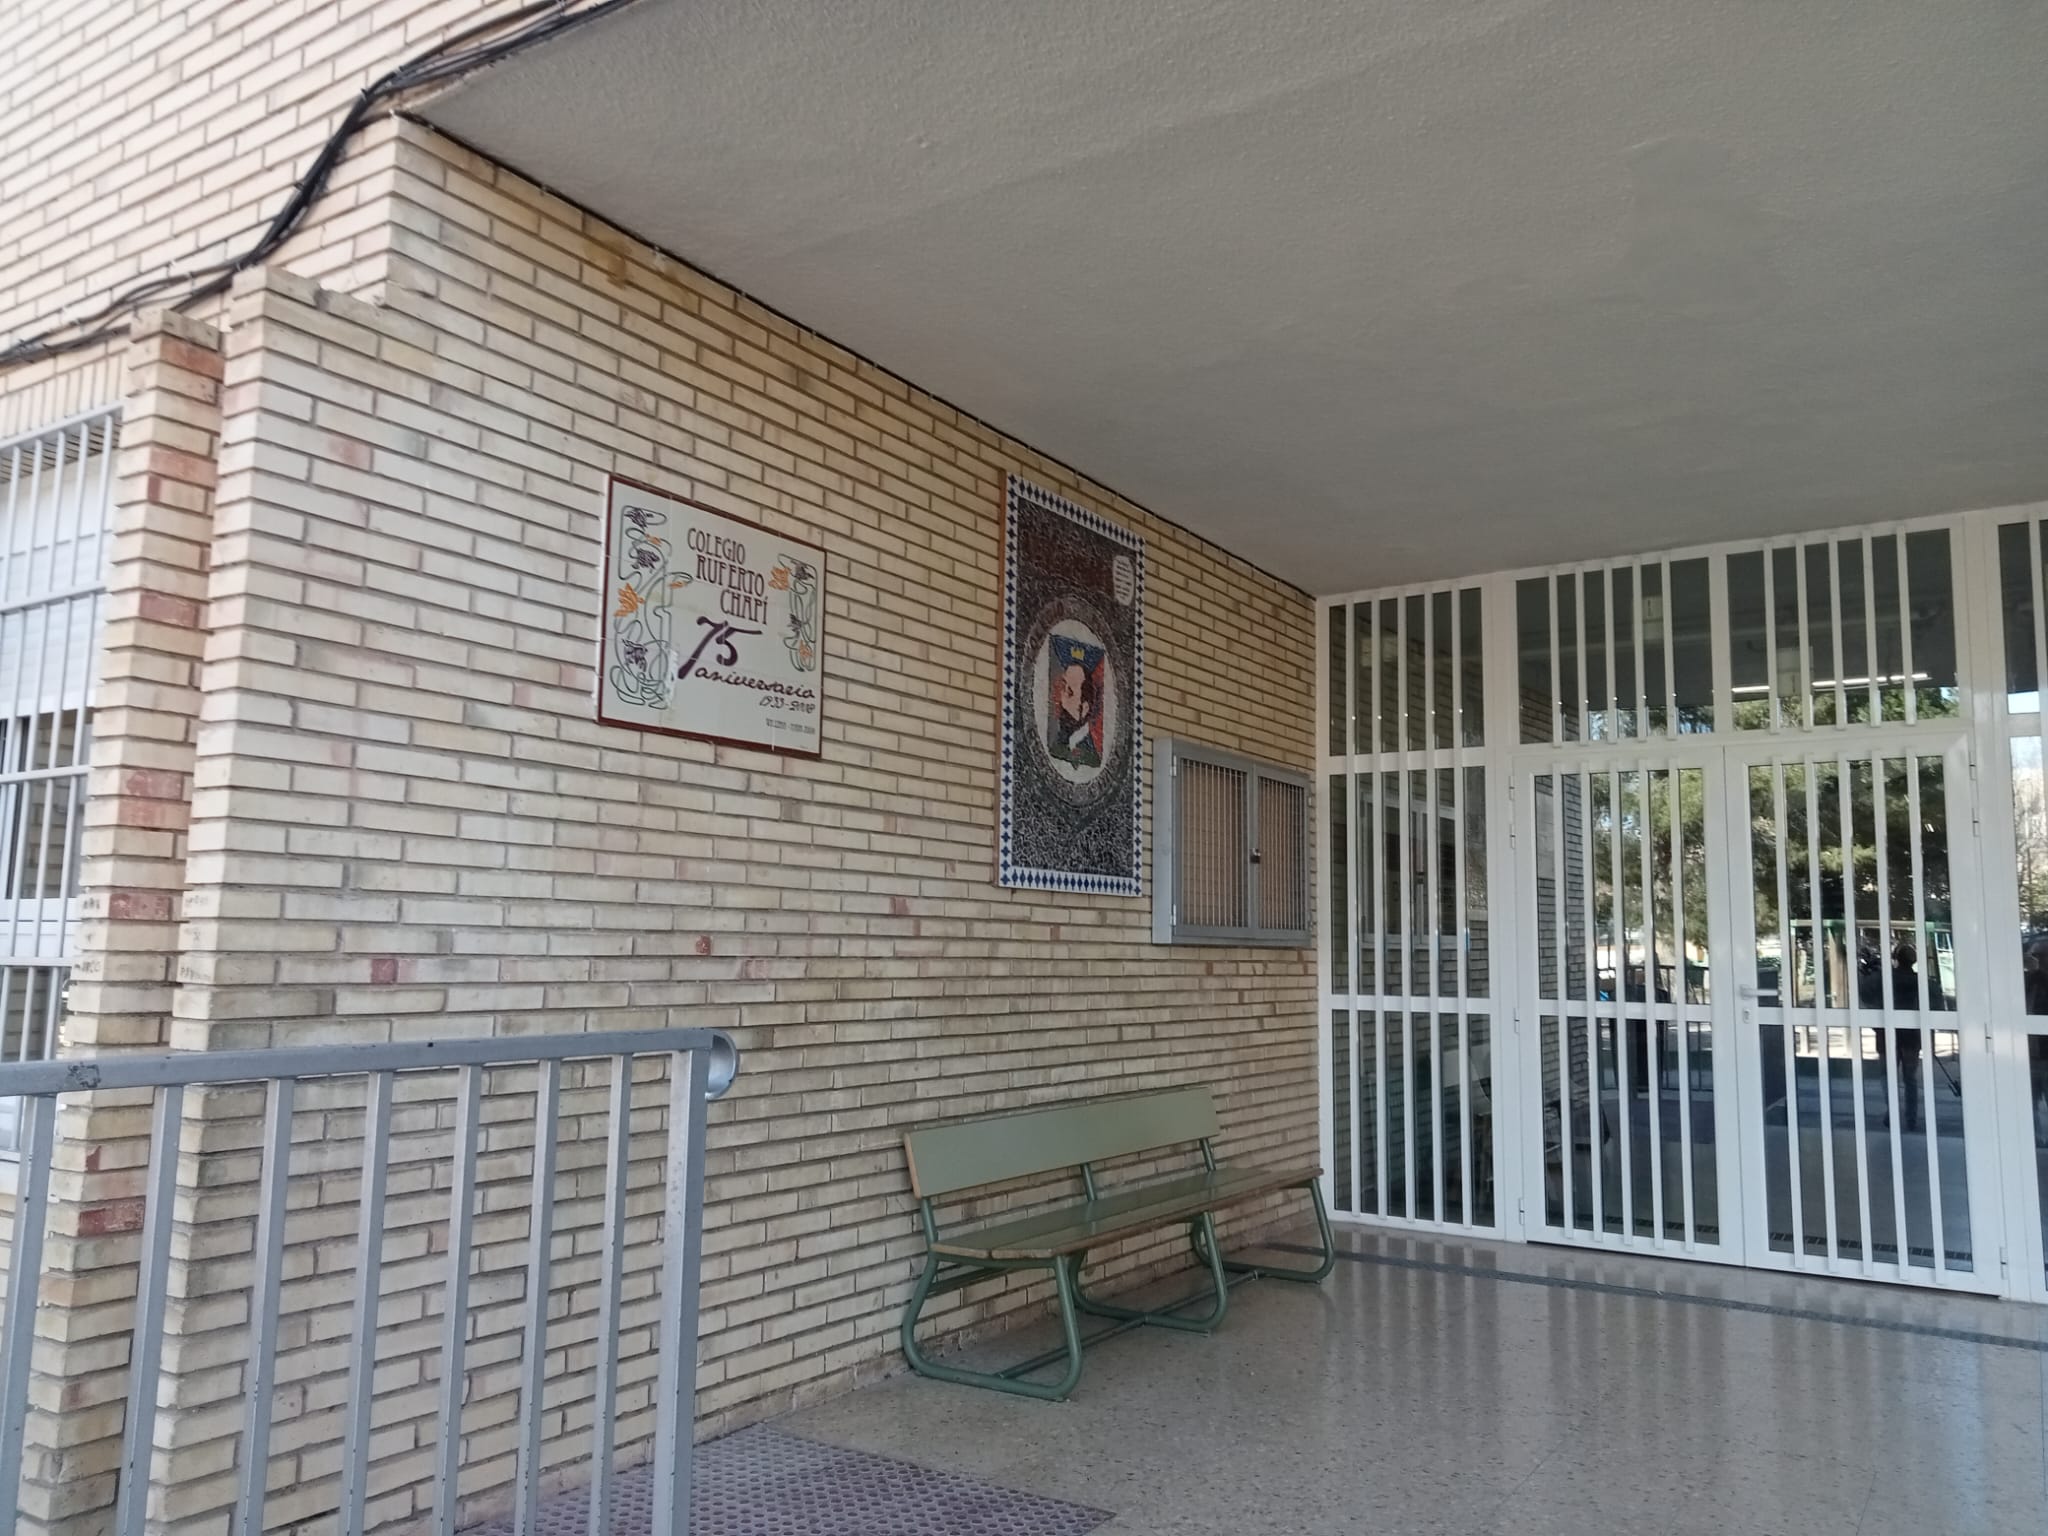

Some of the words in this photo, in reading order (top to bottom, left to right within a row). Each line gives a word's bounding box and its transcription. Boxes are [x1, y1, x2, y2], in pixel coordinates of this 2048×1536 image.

[687, 527, 746, 565] COLEGIO
[720, 588, 769, 625] CHAPÍ
[677, 615, 763, 679] 75
[694, 666, 816, 699] aniversario
